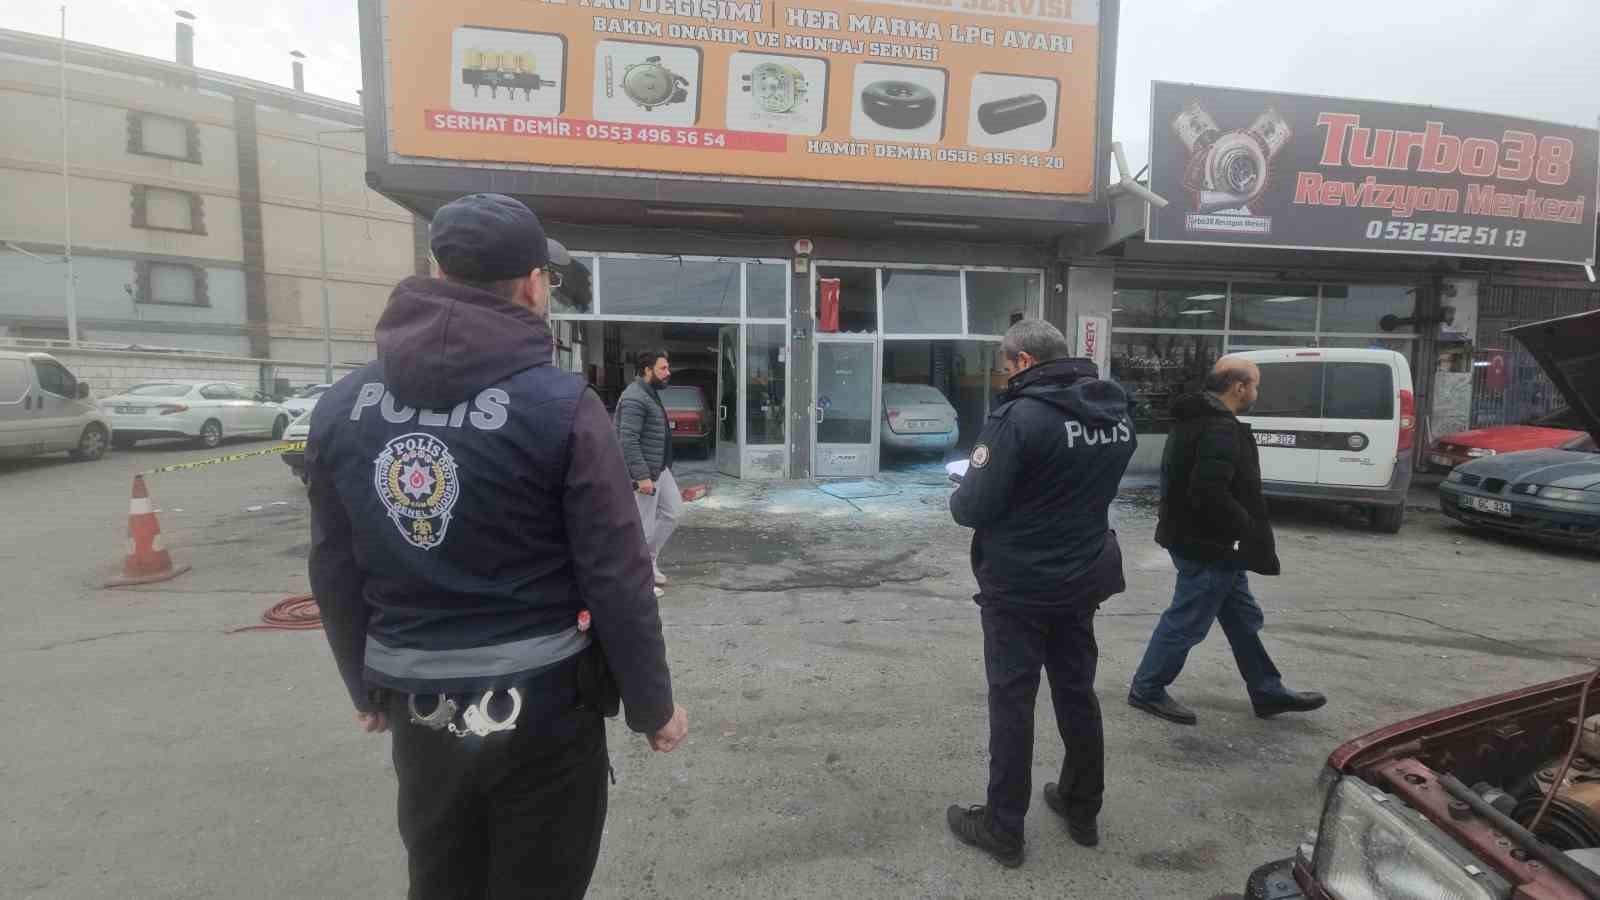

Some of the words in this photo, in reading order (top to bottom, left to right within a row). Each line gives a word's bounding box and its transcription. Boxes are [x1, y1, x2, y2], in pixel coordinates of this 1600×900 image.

[593, 16, 662, 37] BAKIM
[667, 24, 749, 45] ONARIM
[754, 31, 780, 48] VE
[784, 35, 866, 55] MONTAJ
[786, 7, 840, 30] HER
[849, 15, 943, 41] MARKA
[951, 24, 996, 46] LPG
[1003, 30, 1073, 53] AYARI
[434, 113, 508, 132] SERHAT
[513, 115, 570, 137] DEMİR
[586, 124, 633, 142] 0553
[637, 128, 671, 144] 496
[676, 130, 698, 146] 56
[703, 132, 726, 147] 54
[807, 138, 869, 156] HAMİT
[875, 143, 932, 161] DEMİR
[1316, 111, 1575, 186] Turbo38
[1293, 171, 1459, 218] Revizyon
[1463, 184, 1586, 225] Merkezi
[1365, 219, 1382, 239] 0
[1383, 221, 1429, 241] 532
[1430, 223, 1473, 243] 522
[1474, 226, 1498, 246] 51
[1503, 229, 1527, 248] 13
